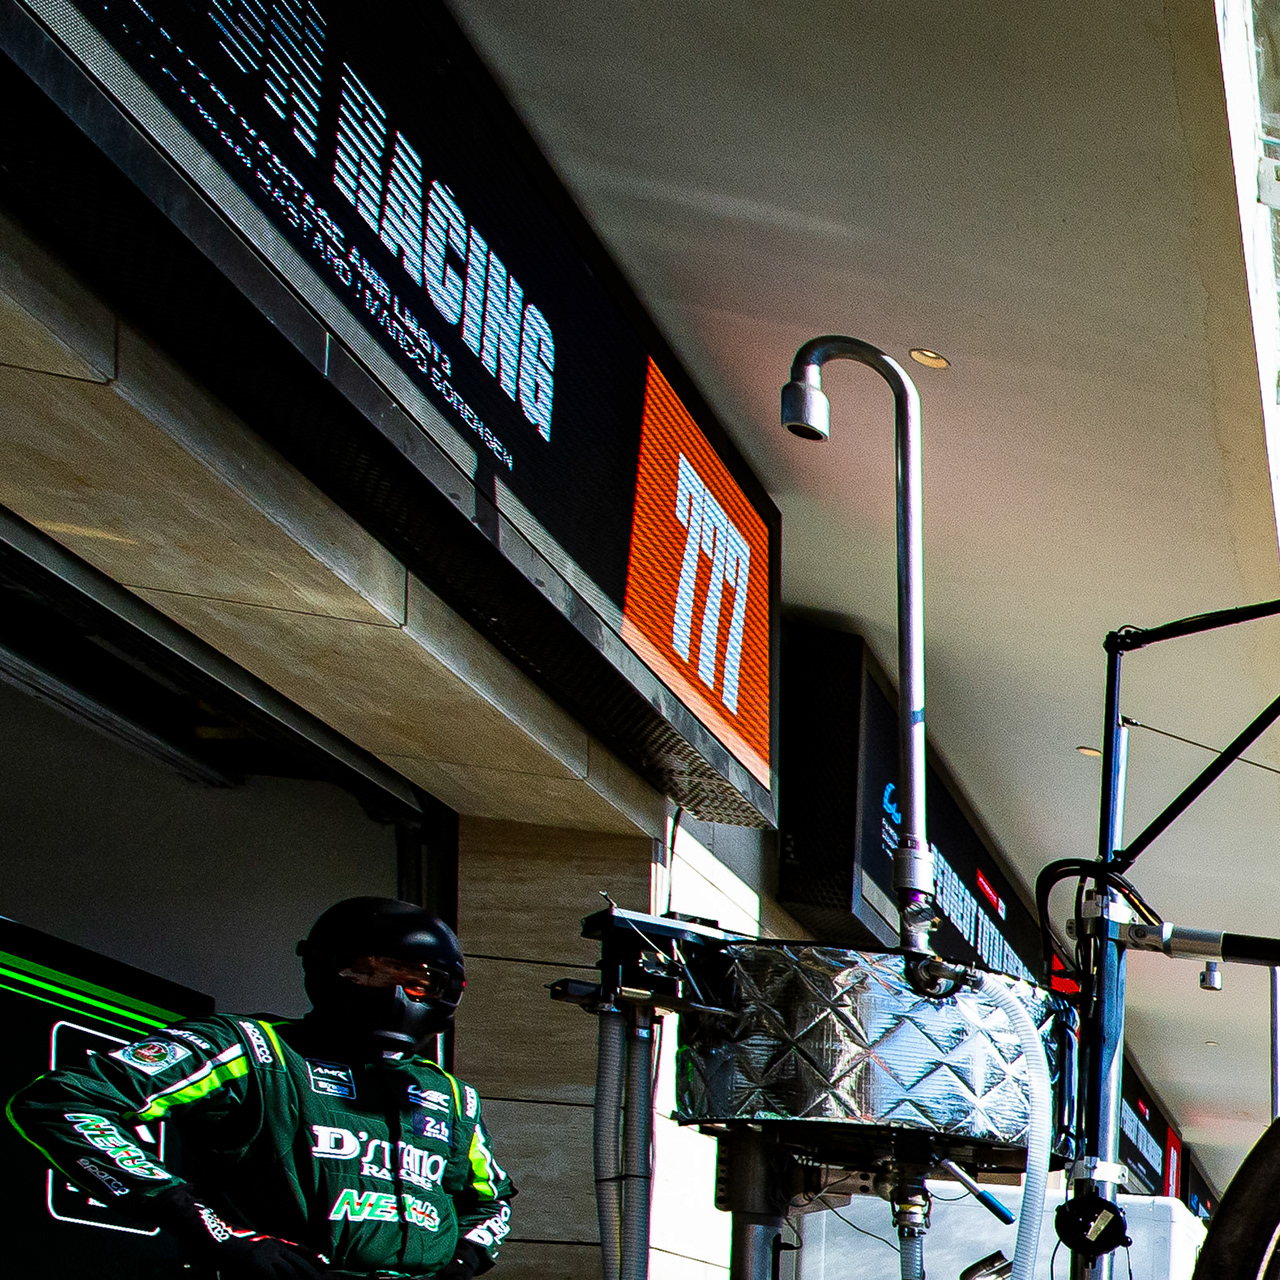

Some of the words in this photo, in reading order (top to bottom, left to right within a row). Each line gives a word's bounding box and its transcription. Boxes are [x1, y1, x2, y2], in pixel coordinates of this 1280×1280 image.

[333, 62, 556, 442] RACING
[672, 452, 751, 715] 777
[64, 1113, 173, 1180] NEXUS
[76, 1157, 130, 1197] sparco
